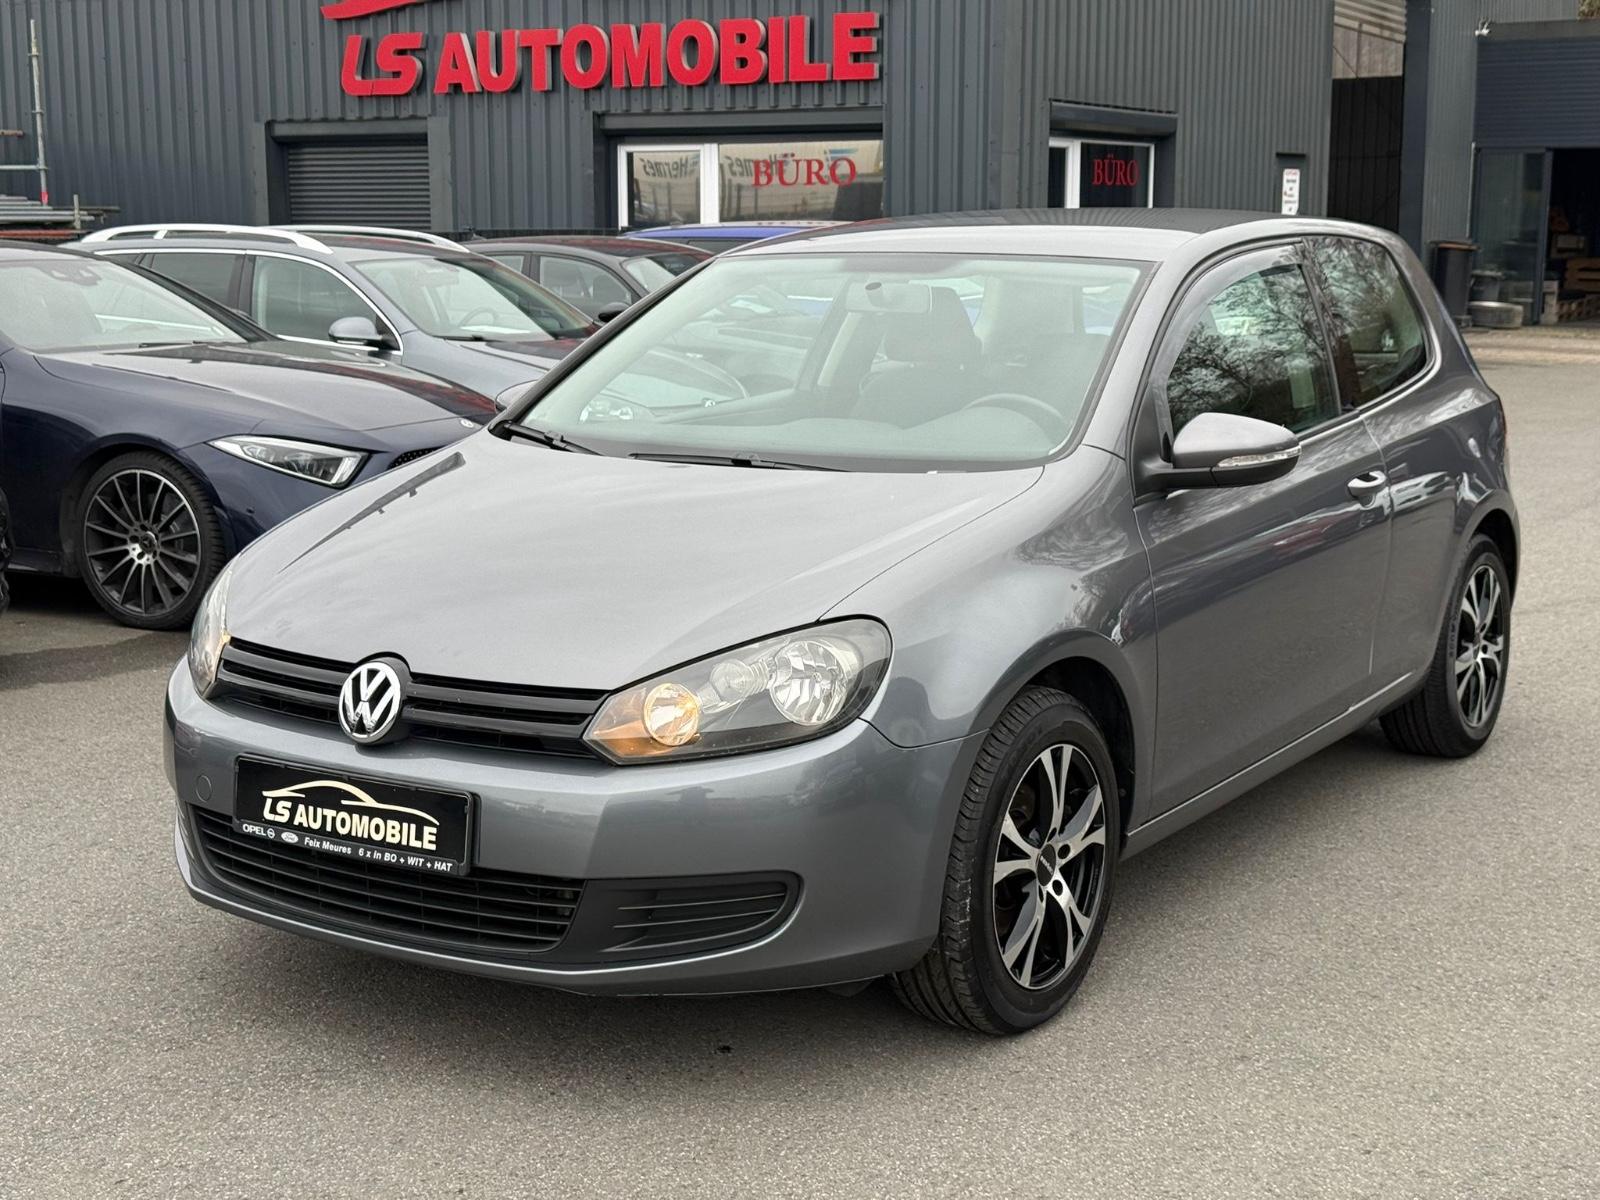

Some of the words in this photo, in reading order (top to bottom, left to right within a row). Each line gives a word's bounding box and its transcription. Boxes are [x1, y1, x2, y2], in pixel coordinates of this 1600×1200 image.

[341, 32, 426, 97] LS
[434, 11, 881, 95] AUTOMOBILE
[752, 153, 857, 187] BÜRO
[1092, 153, 1139, 186] BÜRO
[242, 823, 266, 837] OPEL
[322, 841, 352, 855] Meures
[358, 848, 365, 857] 6
[365, 850, 371, 858] x
[384, 852, 397, 863] BO
[407, 856, 424, 867] WIT
[433, 860, 452, 872] HAT
[263, 798, 292, 824] LS
[293, 804, 437, 851] AUTOMOBILE
